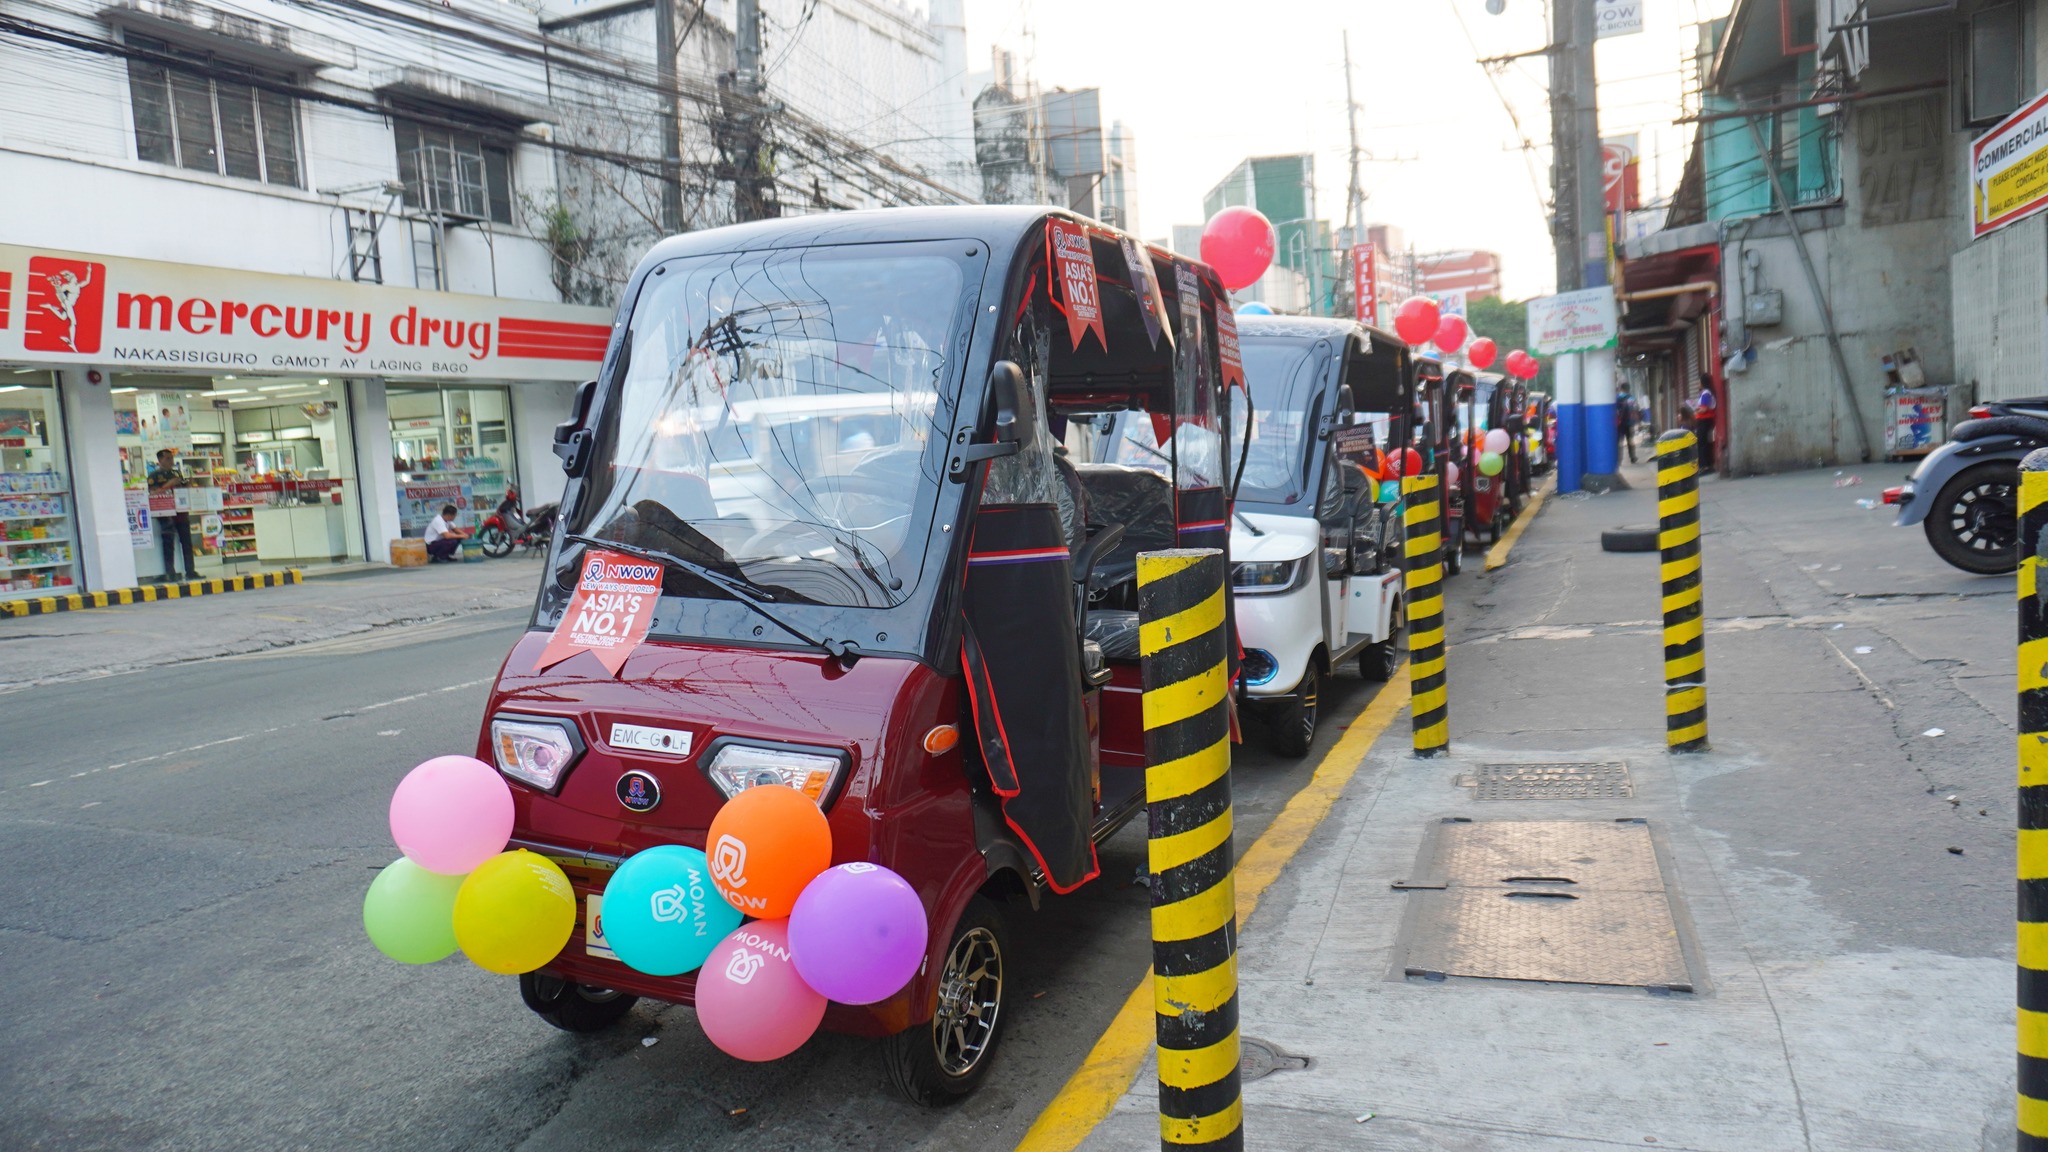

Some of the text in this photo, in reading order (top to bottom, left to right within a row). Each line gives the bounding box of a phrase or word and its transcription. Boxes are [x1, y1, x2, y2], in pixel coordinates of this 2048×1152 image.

[1978, 115, 2048, 174] COMMERCIAL
[1065, 261, 1093, 283] ASIA'S
[117, 292, 491, 361] mercury drug
[114, 347, 468, 373] NAKASISIGURO GAMOT AY LAGING BAGO
[606, 563, 660, 581] NWOW
[581, 581, 655, 593] NEW WAYS OF WORLD
[582, 593, 642, 613] ASIA'S
[687, 868, 707, 937] NWOW
[732, 931, 791, 962] NWOW
